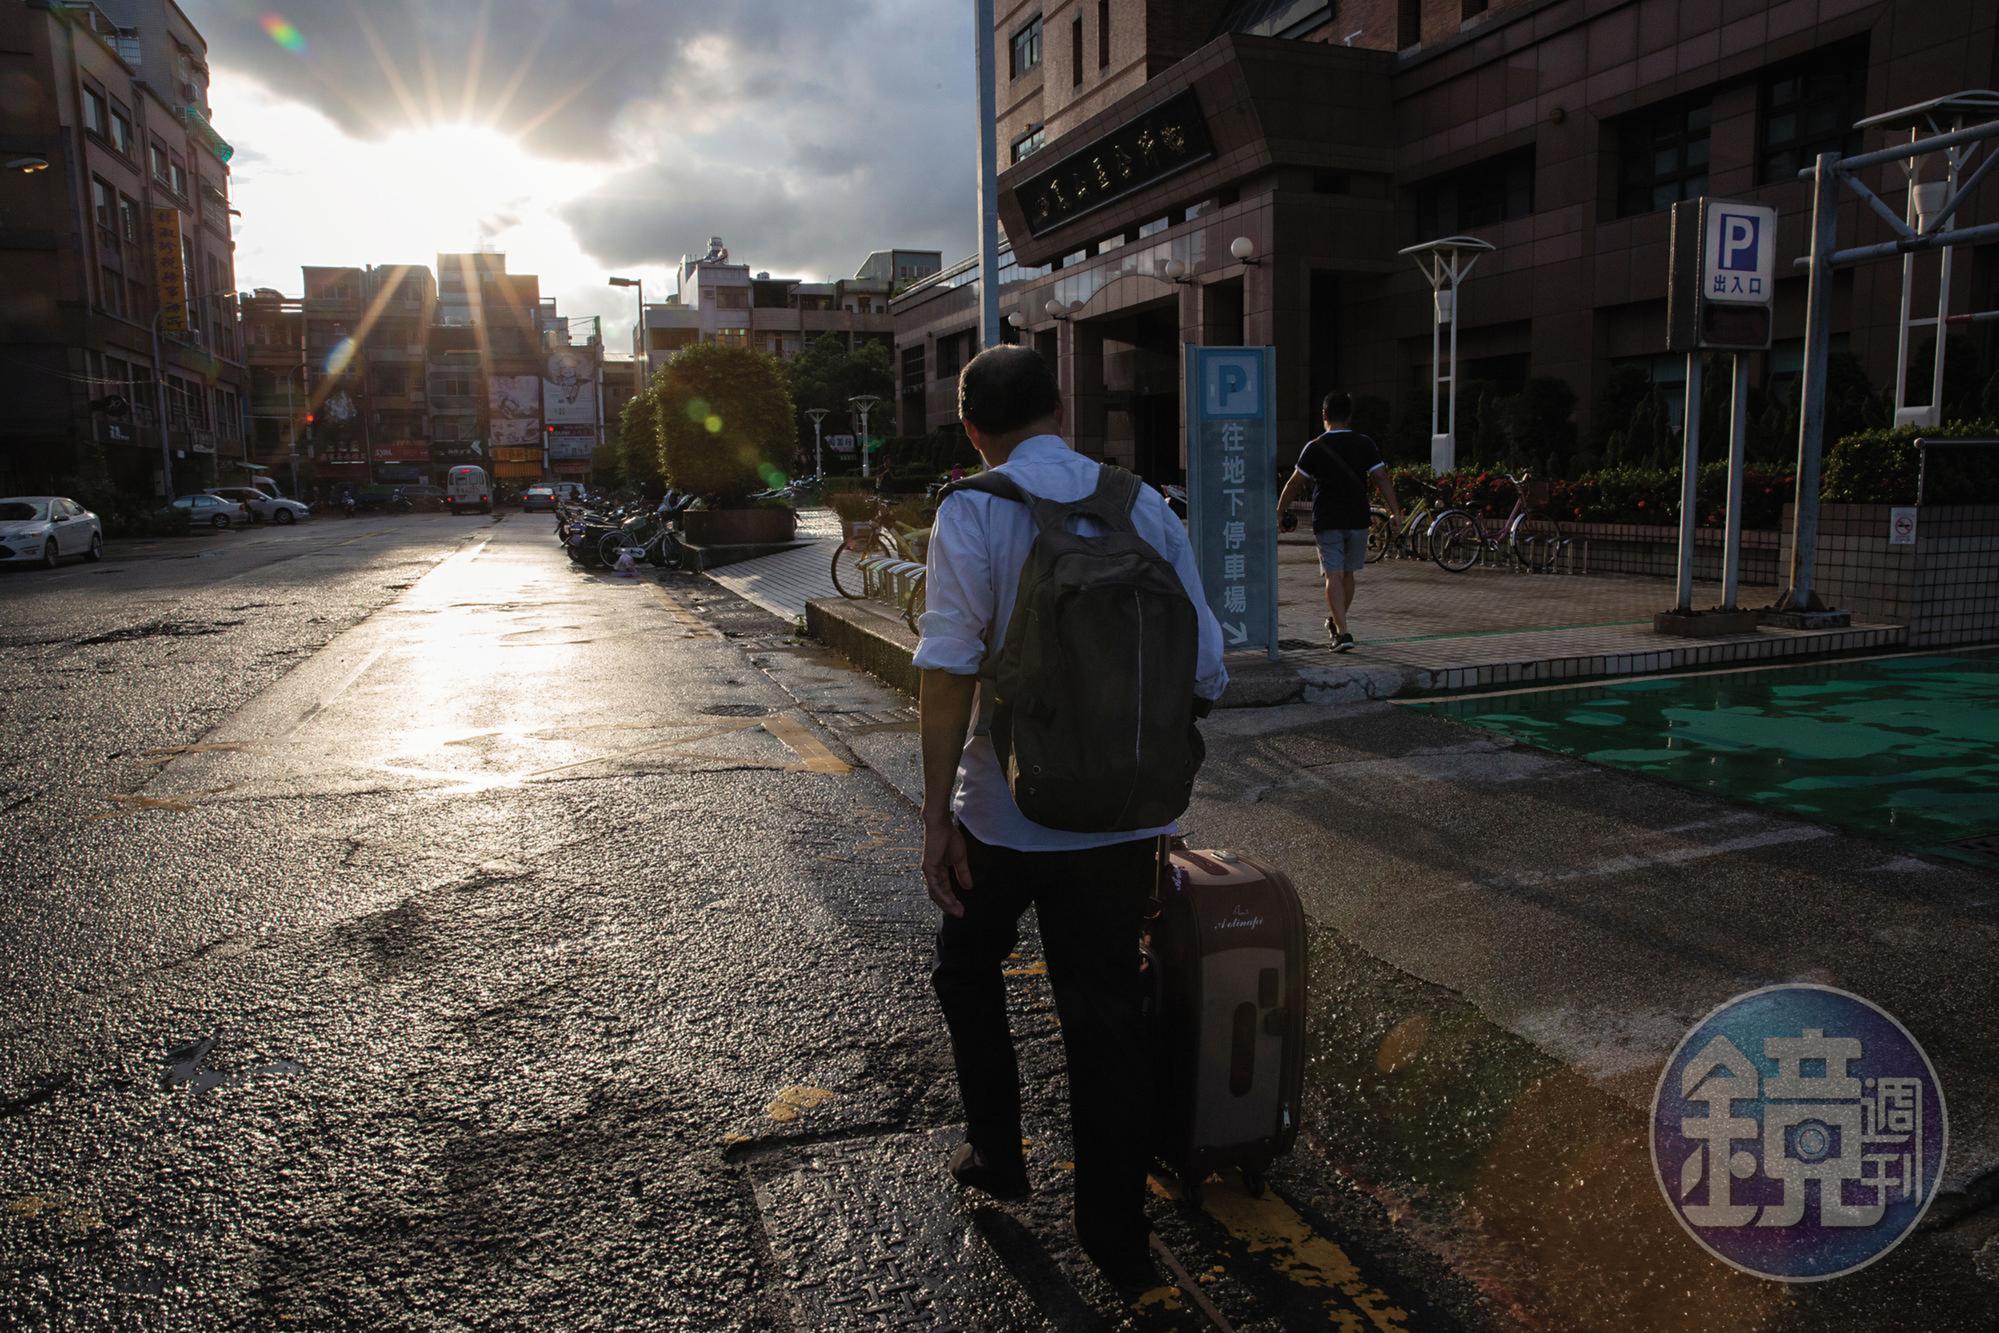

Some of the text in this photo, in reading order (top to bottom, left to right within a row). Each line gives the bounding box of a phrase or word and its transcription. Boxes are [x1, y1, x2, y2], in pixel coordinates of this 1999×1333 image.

[1723, 216, 1754, 269] P
[1713, 274, 1762, 294] 出入口
[1218, 364, 1248, 408] P
[1221, 423, 1247, 614] 往地下停車場
